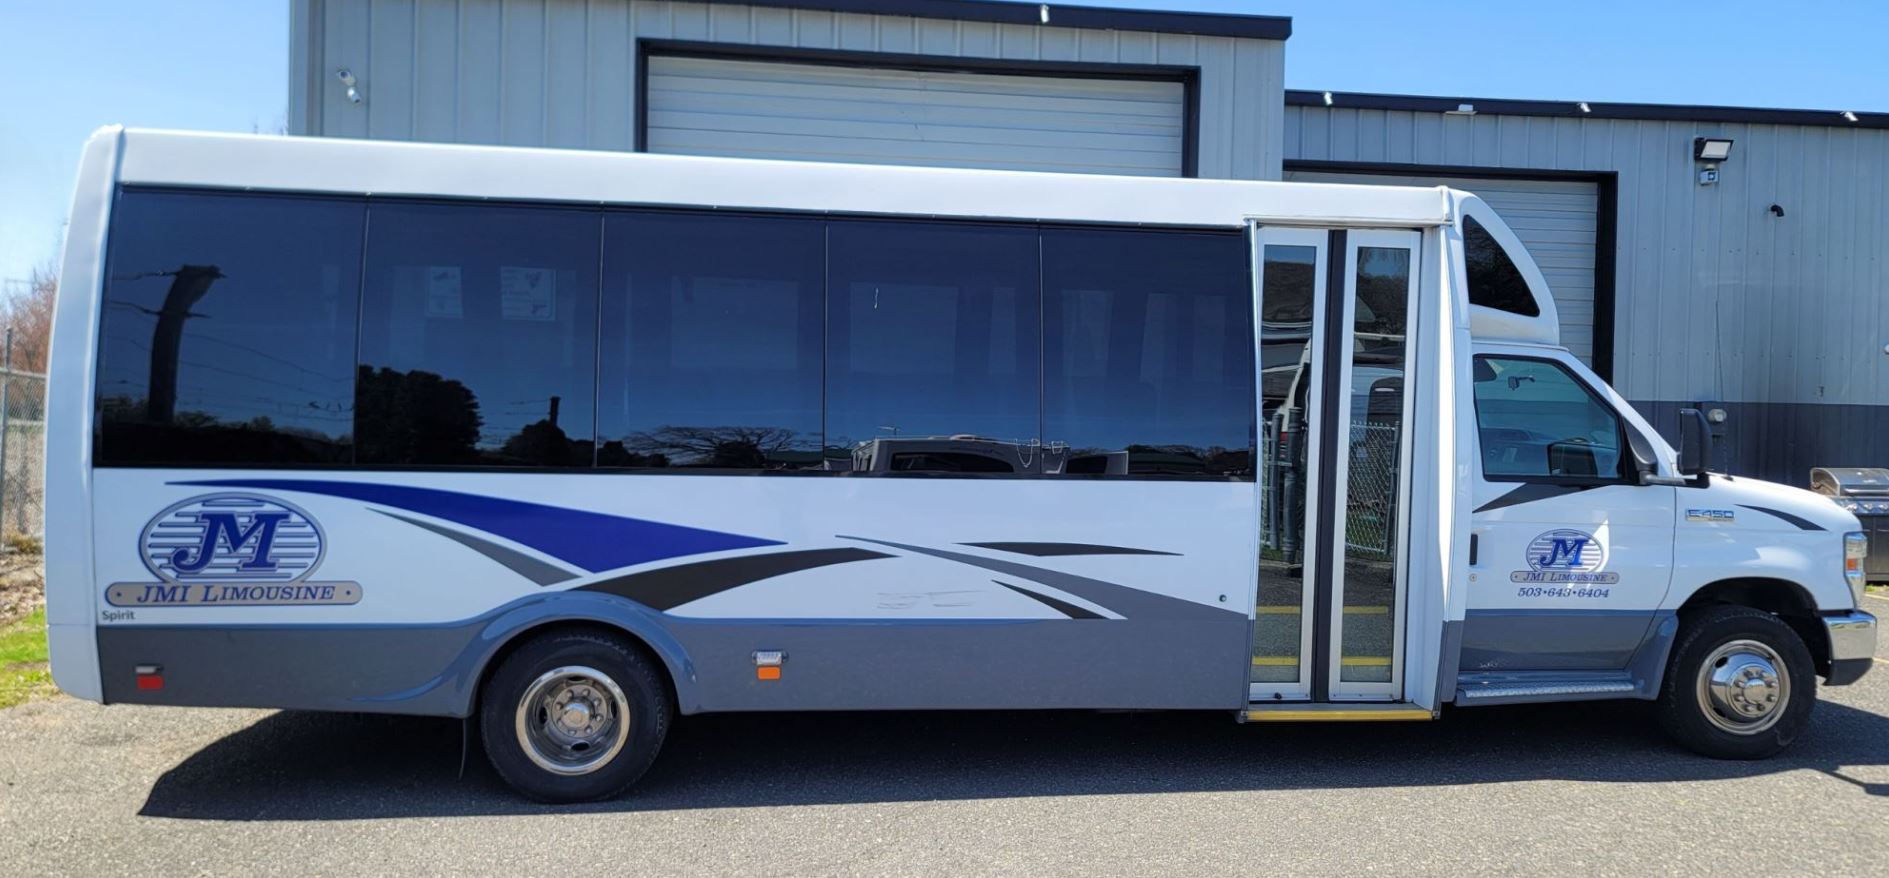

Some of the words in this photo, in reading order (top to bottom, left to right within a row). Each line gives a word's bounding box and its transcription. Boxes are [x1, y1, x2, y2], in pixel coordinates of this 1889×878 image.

[1522, 572, 1547, 582] JMI
[1550, 572, 1609, 583] LIMOUSINE
[137, 585, 192, 604] JMI
[200, 585, 336, 603] LIMOUSINE
[102, 609, 136, 621] Spirit
